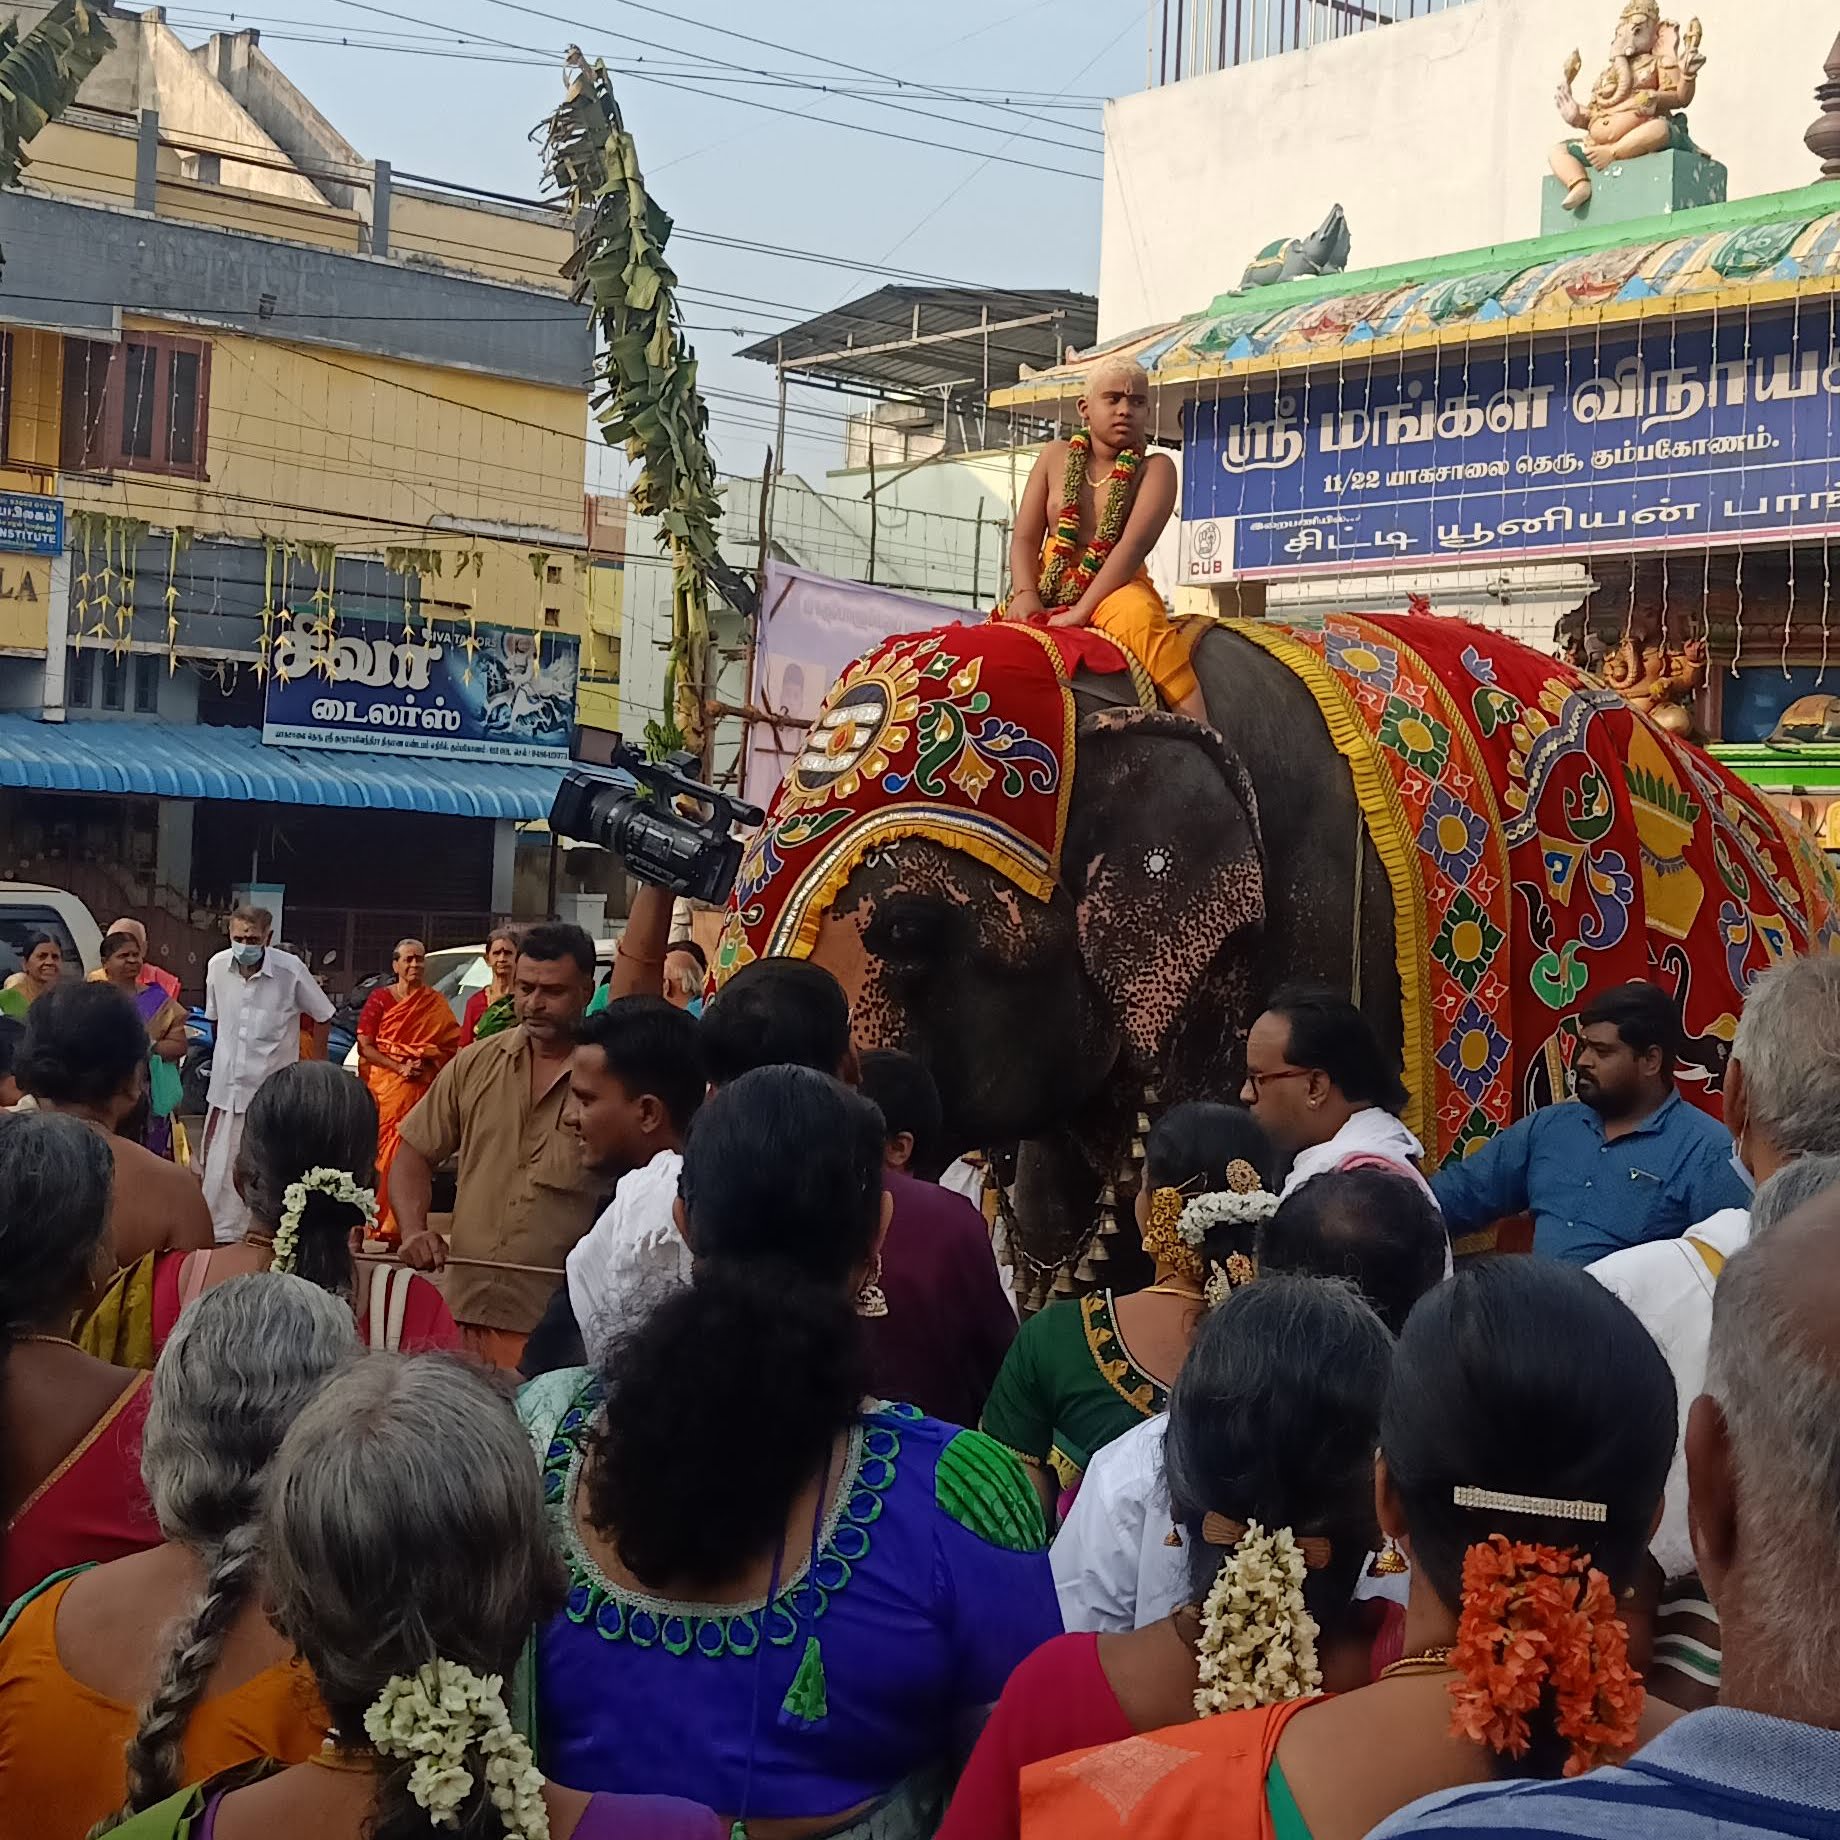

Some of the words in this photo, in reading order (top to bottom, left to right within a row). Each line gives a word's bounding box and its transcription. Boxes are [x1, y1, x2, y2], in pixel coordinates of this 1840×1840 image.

[1320, 379, 1554, 453] மங்கள
[1323, 467, 1381, 496] 11/22
[1386, 459, 1510, 488] யாகசாலை
[1515, 452, 1585, 477] தெரு,
[1590, 424, 1780, 470] கும்பகோணம்.
[1284, 525, 1419, 553] சிட்டி
[1437, 496, 1701, 548] யூனியன்
[1190, 561, 1222, 575] CUB
[311, 693, 462, 731] டைலர்ஸ்
